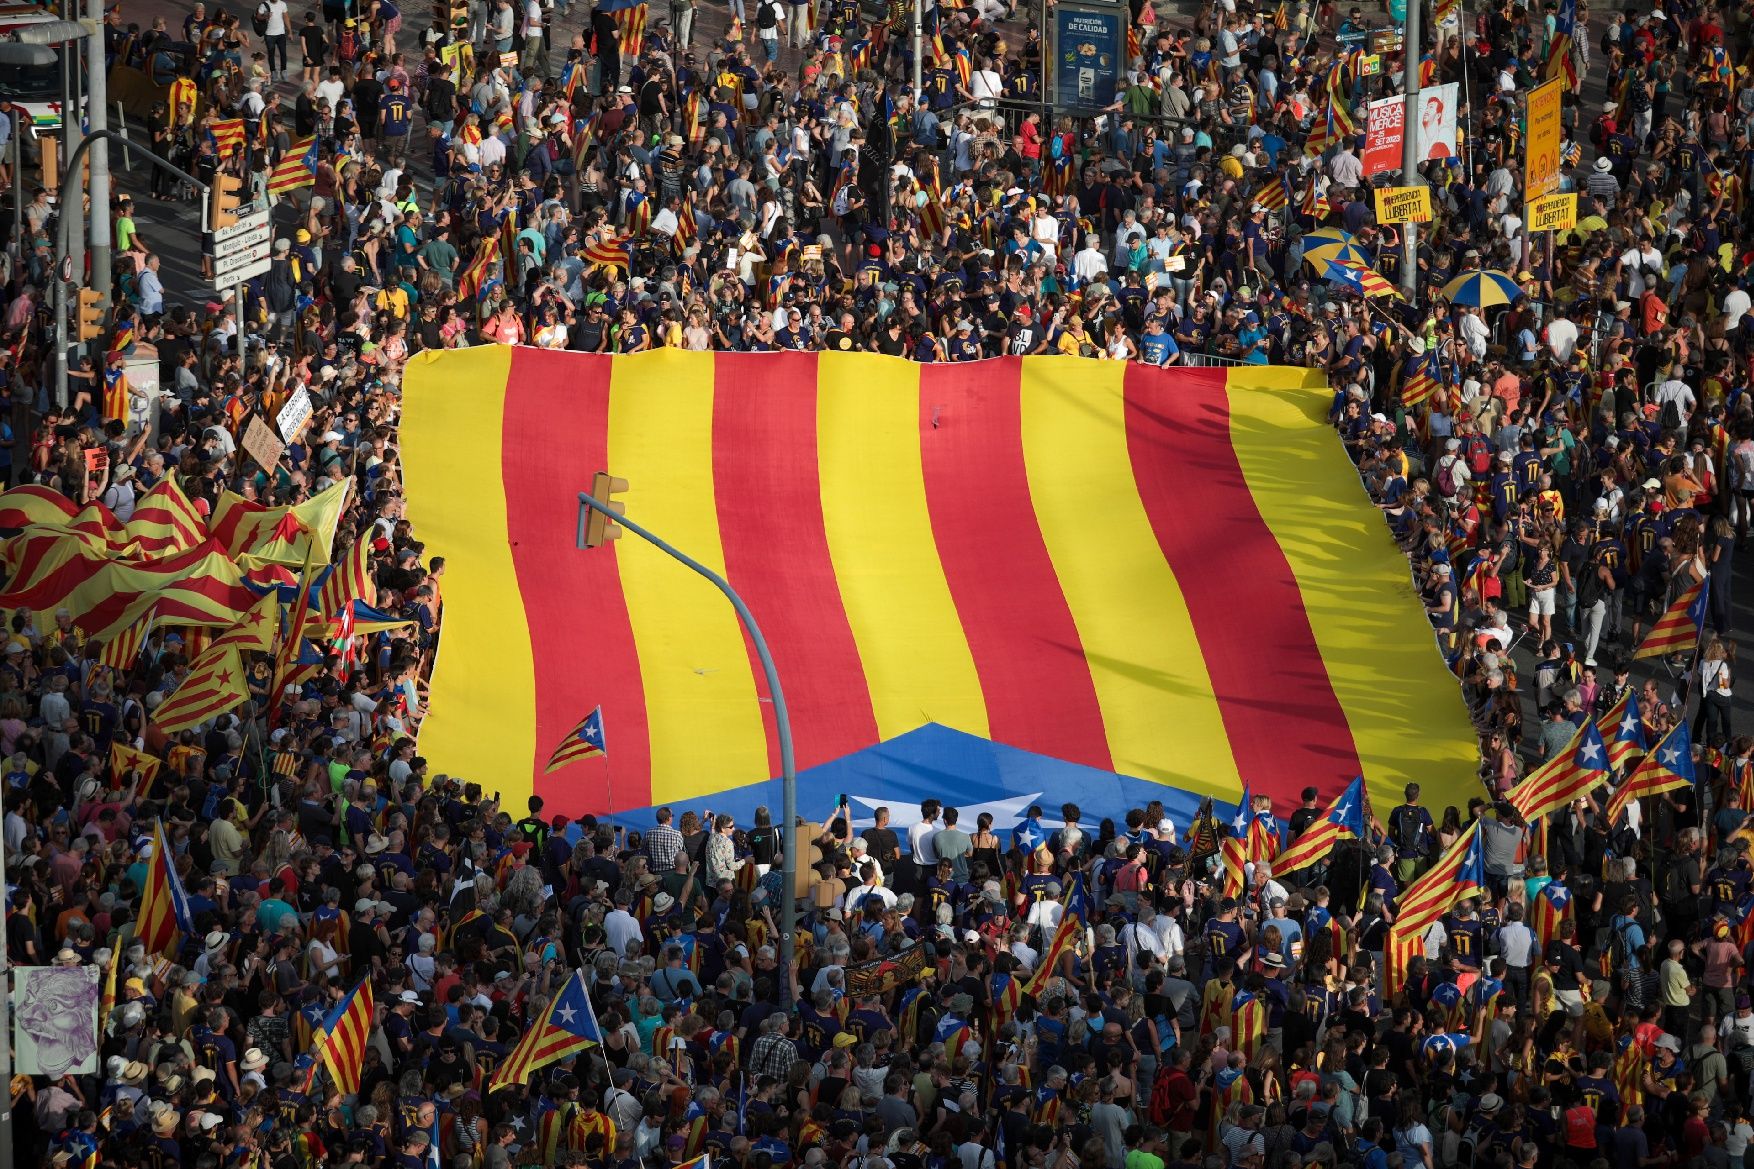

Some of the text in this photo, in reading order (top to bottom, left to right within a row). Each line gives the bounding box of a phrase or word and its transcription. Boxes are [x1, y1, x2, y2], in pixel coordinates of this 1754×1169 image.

[844, 8, 853, 22] 11
[1068, 22, 1107, 34] DE CALIDAD
[936, 77, 947, 94] 11
[1014, 77, 1027, 93] 11
[391, 104, 403, 121] 11
[1375, 134, 1401, 146] SET 2023
[1680, 152, 1691, 169] 11
[1385, 199, 1421, 220] LLIBERTAT
[1527, 463, 1538, 481] 11
[1504, 485, 1516, 503] 11
[1642, 532, 1654, 550] 11
[86, 714, 100, 734] 11
[1717, 883, 1734, 902] 11
[1210, 934, 1225, 957] 11
[1454, 935, 1470, 957] 11
